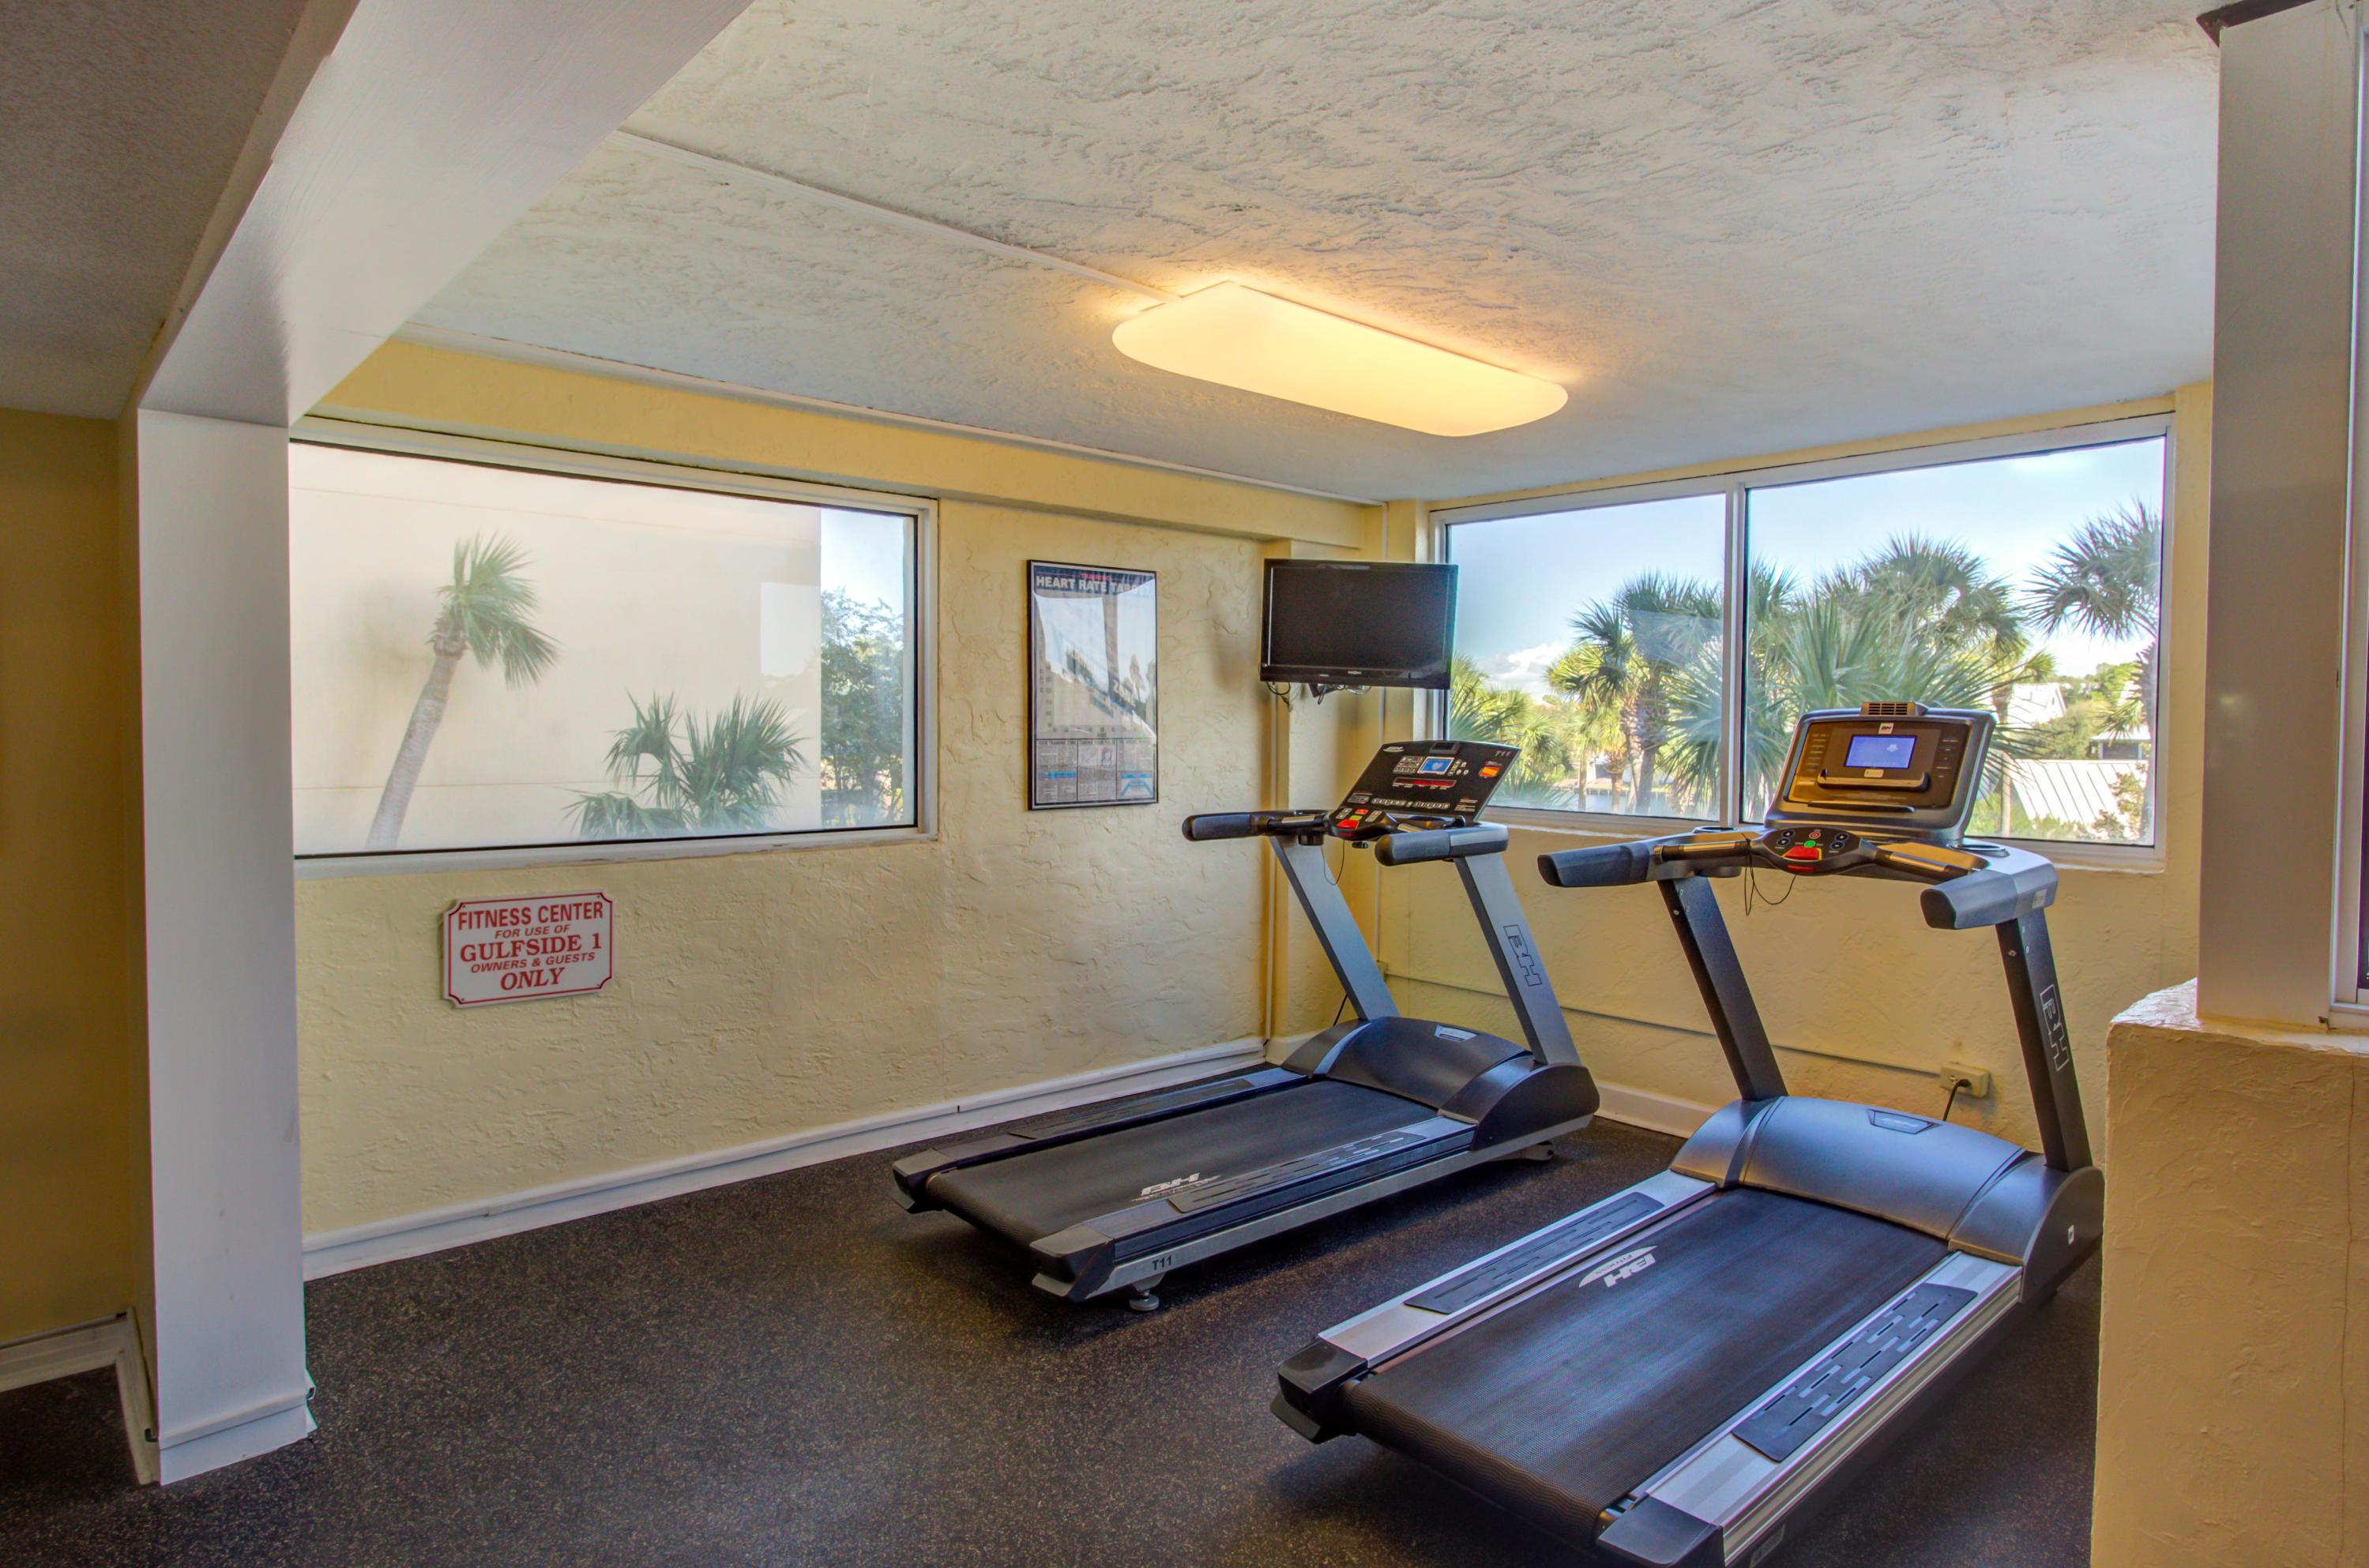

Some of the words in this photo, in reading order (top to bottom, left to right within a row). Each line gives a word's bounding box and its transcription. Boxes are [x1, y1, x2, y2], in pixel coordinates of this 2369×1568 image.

[1036, 575, 1075, 589] HEART
[1078, 579, 1107, 592] RATE
[457, 907, 532, 931] FITNESS
[537, 901, 604, 923] CENTER
[494, 929, 521, 939] FOR
[525, 926, 550, 937] USE
[554, 924, 570, 934] OF
[459, 934, 582, 962] GULFSIDE
[592, 933, 602, 949] 1
[471, 958, 527, 973] OWNERS
[531, 957, 541, 968] &
[546, 952, 596, 965] GUESTS
[500, 967, 566, 991] ONLY
[1152, 1255, 1172, 1270] T11
